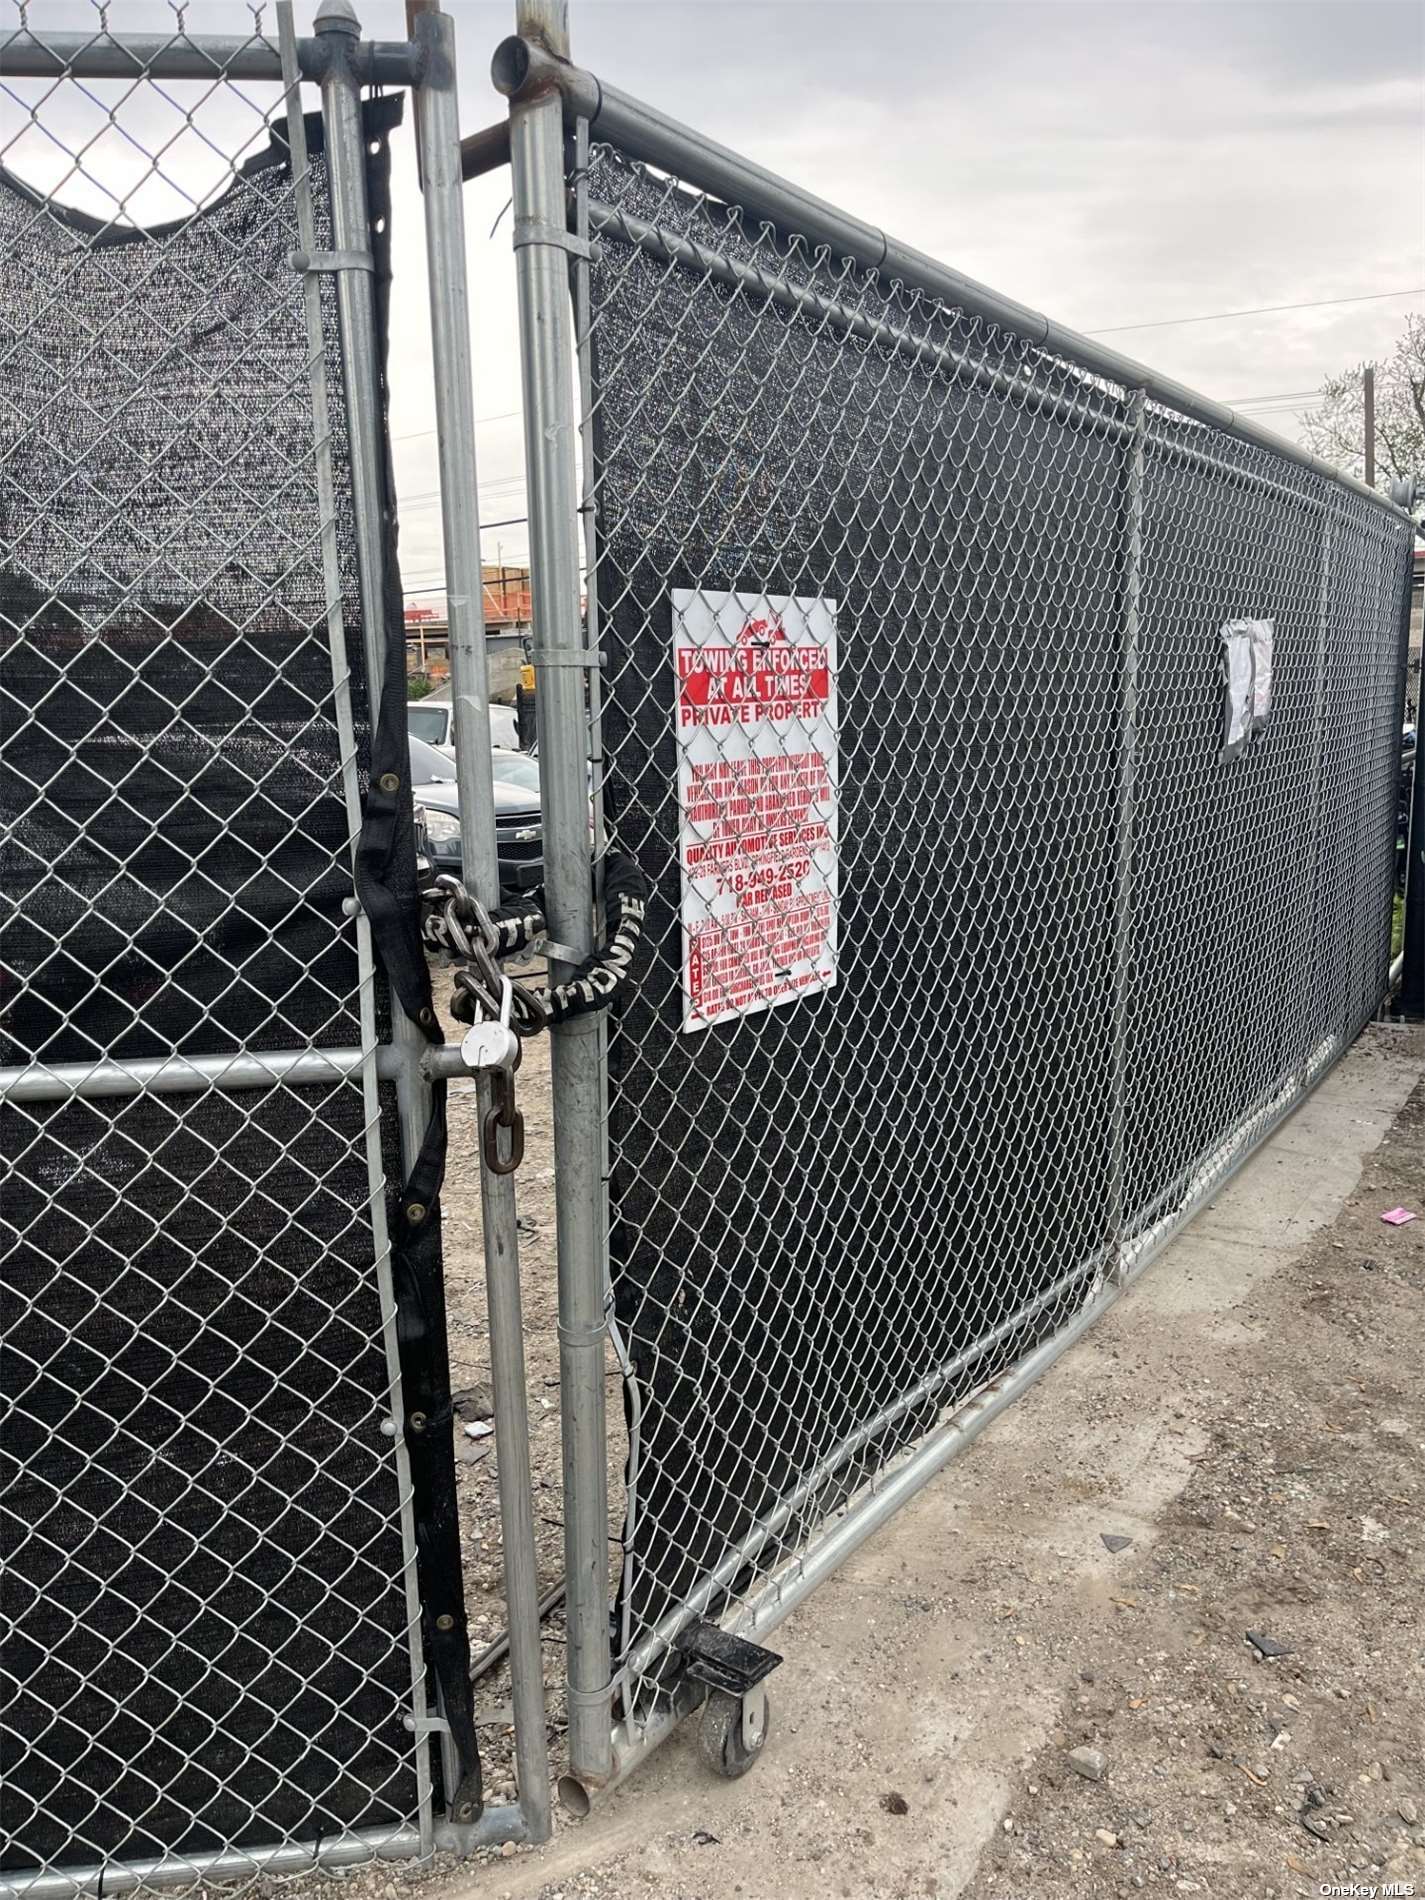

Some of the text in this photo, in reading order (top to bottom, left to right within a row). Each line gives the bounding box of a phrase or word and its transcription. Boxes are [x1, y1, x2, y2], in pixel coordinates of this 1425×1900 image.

[681, 650, 748, 673] TOWING
[707, 676, 728, 700] AT
[732, 675, 761, 699] ALL
[681, 702, 825, 727] PRIVAE PROPERT
[725, 833, 776, 857] AUTOMOTVE
[779, 827, 814, 846] SERVCES
[754, 882, 791, 904] RELASED
